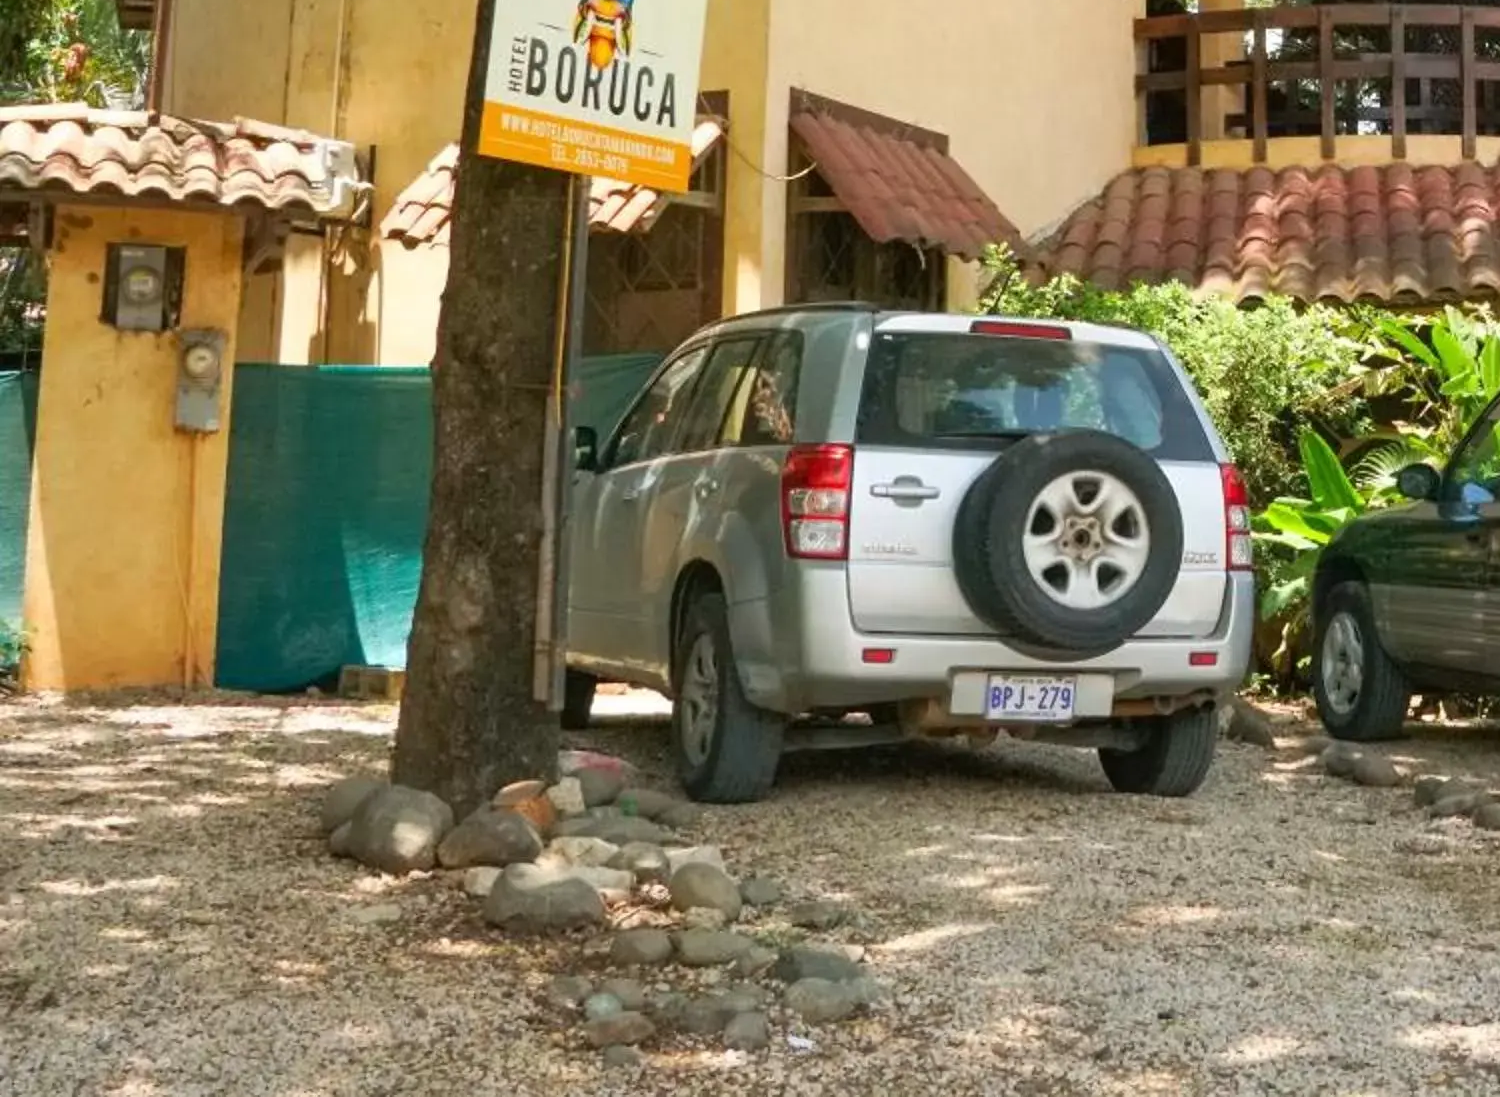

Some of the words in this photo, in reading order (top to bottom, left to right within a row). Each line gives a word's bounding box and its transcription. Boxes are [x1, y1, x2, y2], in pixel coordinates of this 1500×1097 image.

[508, 35, 529, 93] HOTEL
[525, 37, 676, 128] BORUCA
[990, 685, 1072, 710] BPJ-279
